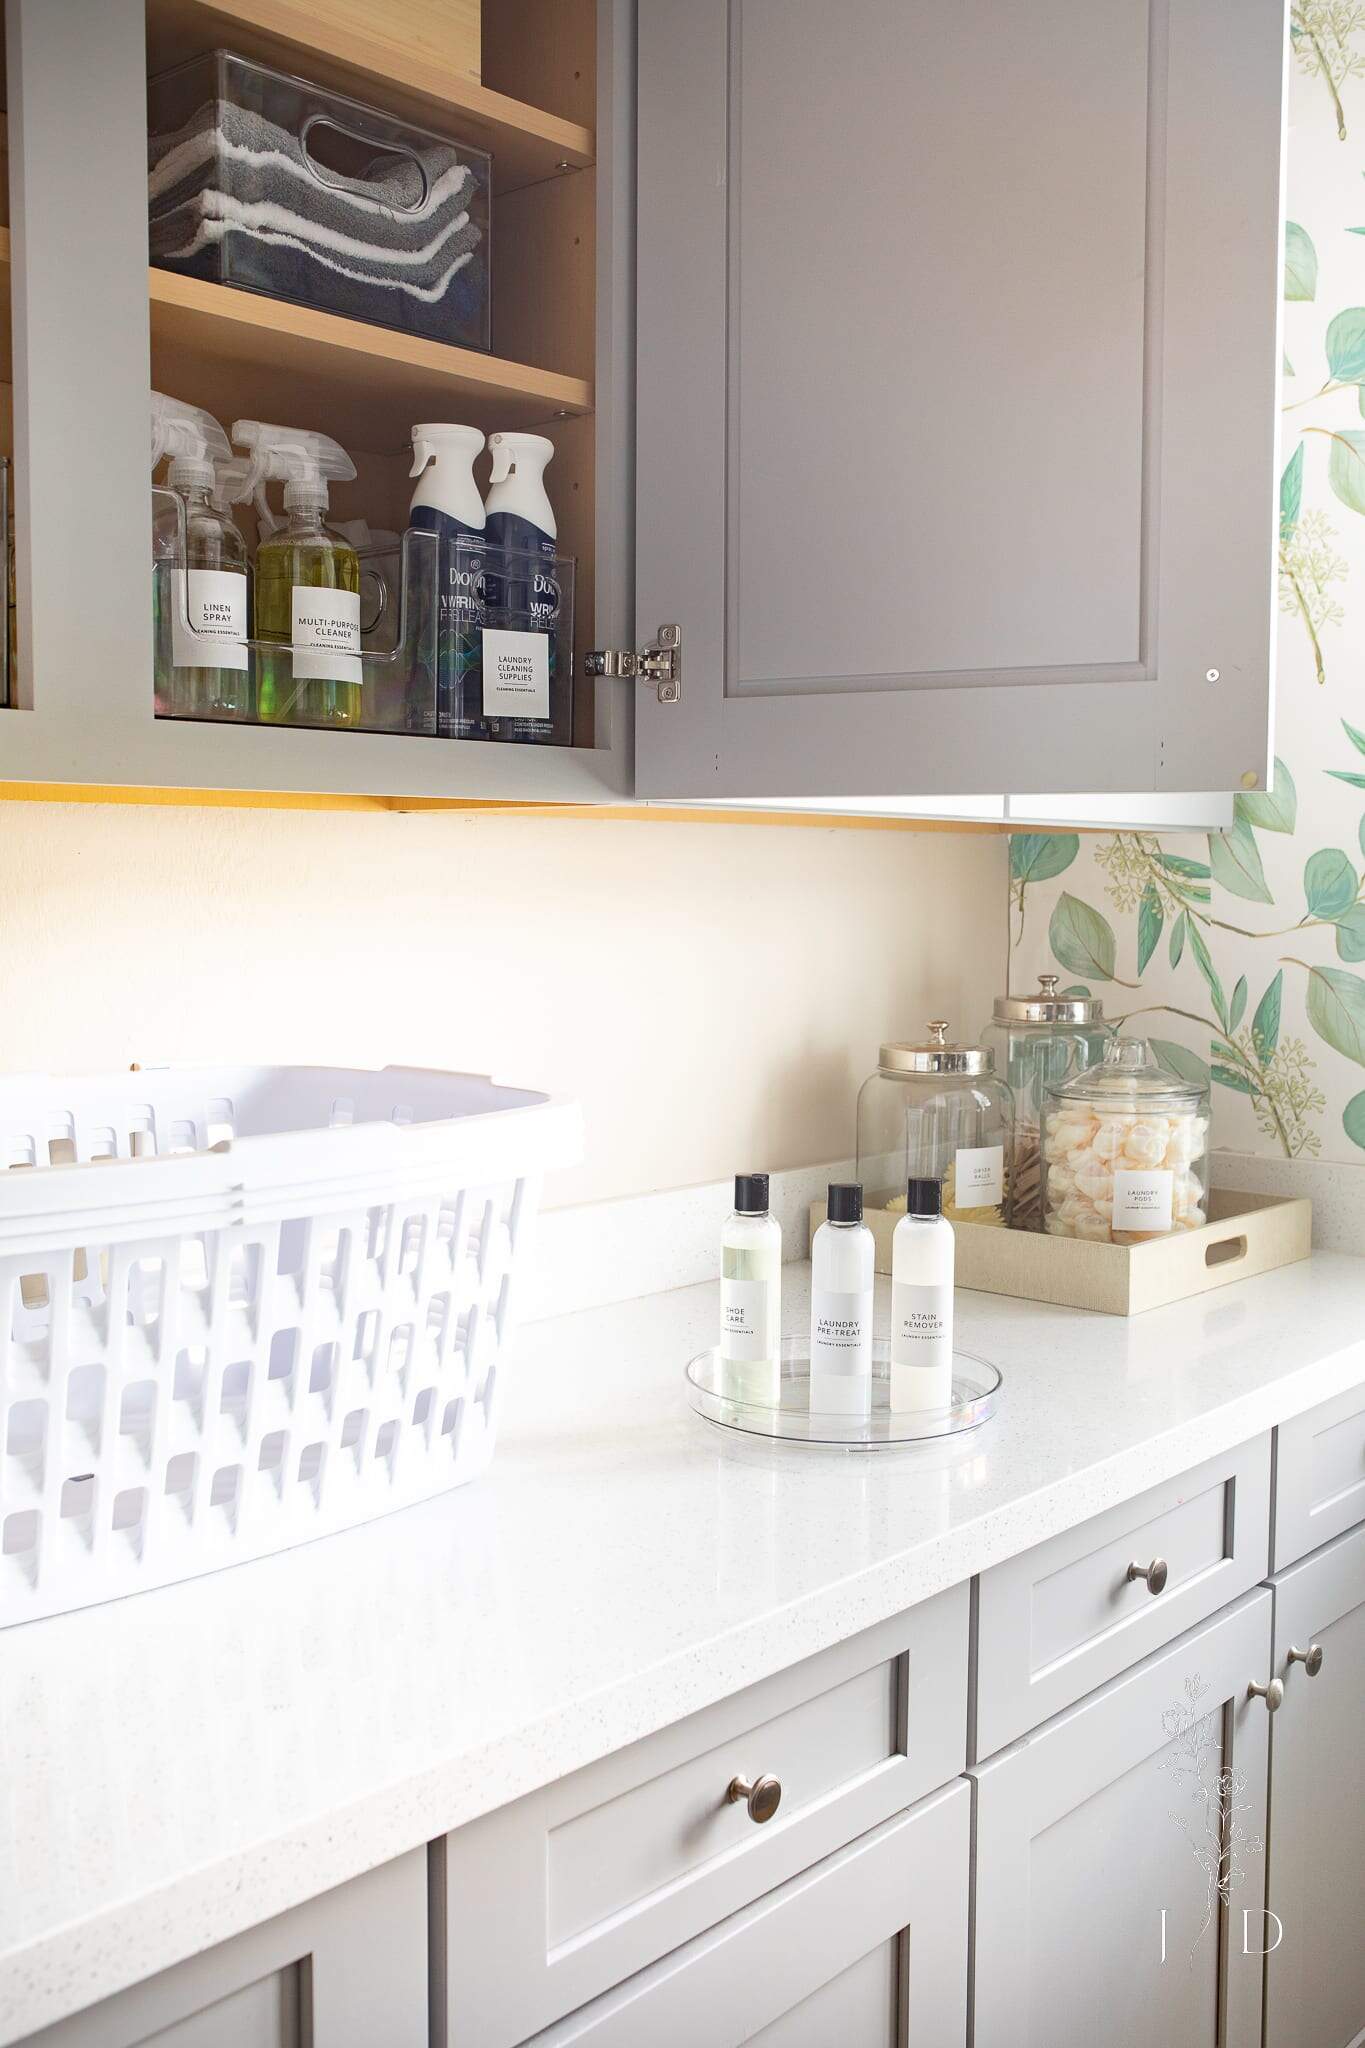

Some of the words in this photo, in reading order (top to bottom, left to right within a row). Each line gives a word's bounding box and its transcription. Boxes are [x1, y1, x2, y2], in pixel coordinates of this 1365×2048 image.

[203, 603, 231, 613] LINEN
[203, 613, 232, 622] SPRAY
[298, 617, 360, 632] MULTI-PURPOSE
[217, 629, 241, 637] ESSENTIALS
[315, 627, 352, 639] CLEANER
[498, 655, 533, 665] LAUNDRY
[497, 664, 534, 673] CLEANING
[498, 672, 533, 682] SUPPLIES
[911, 1313, 937, 1321] STAIN
[819, 1318, 859, 1328] LAUNDRY
[903, 1320, 944, 1329] REMOVER
[817, 1326, 861, 1337] PRE-TREAT
